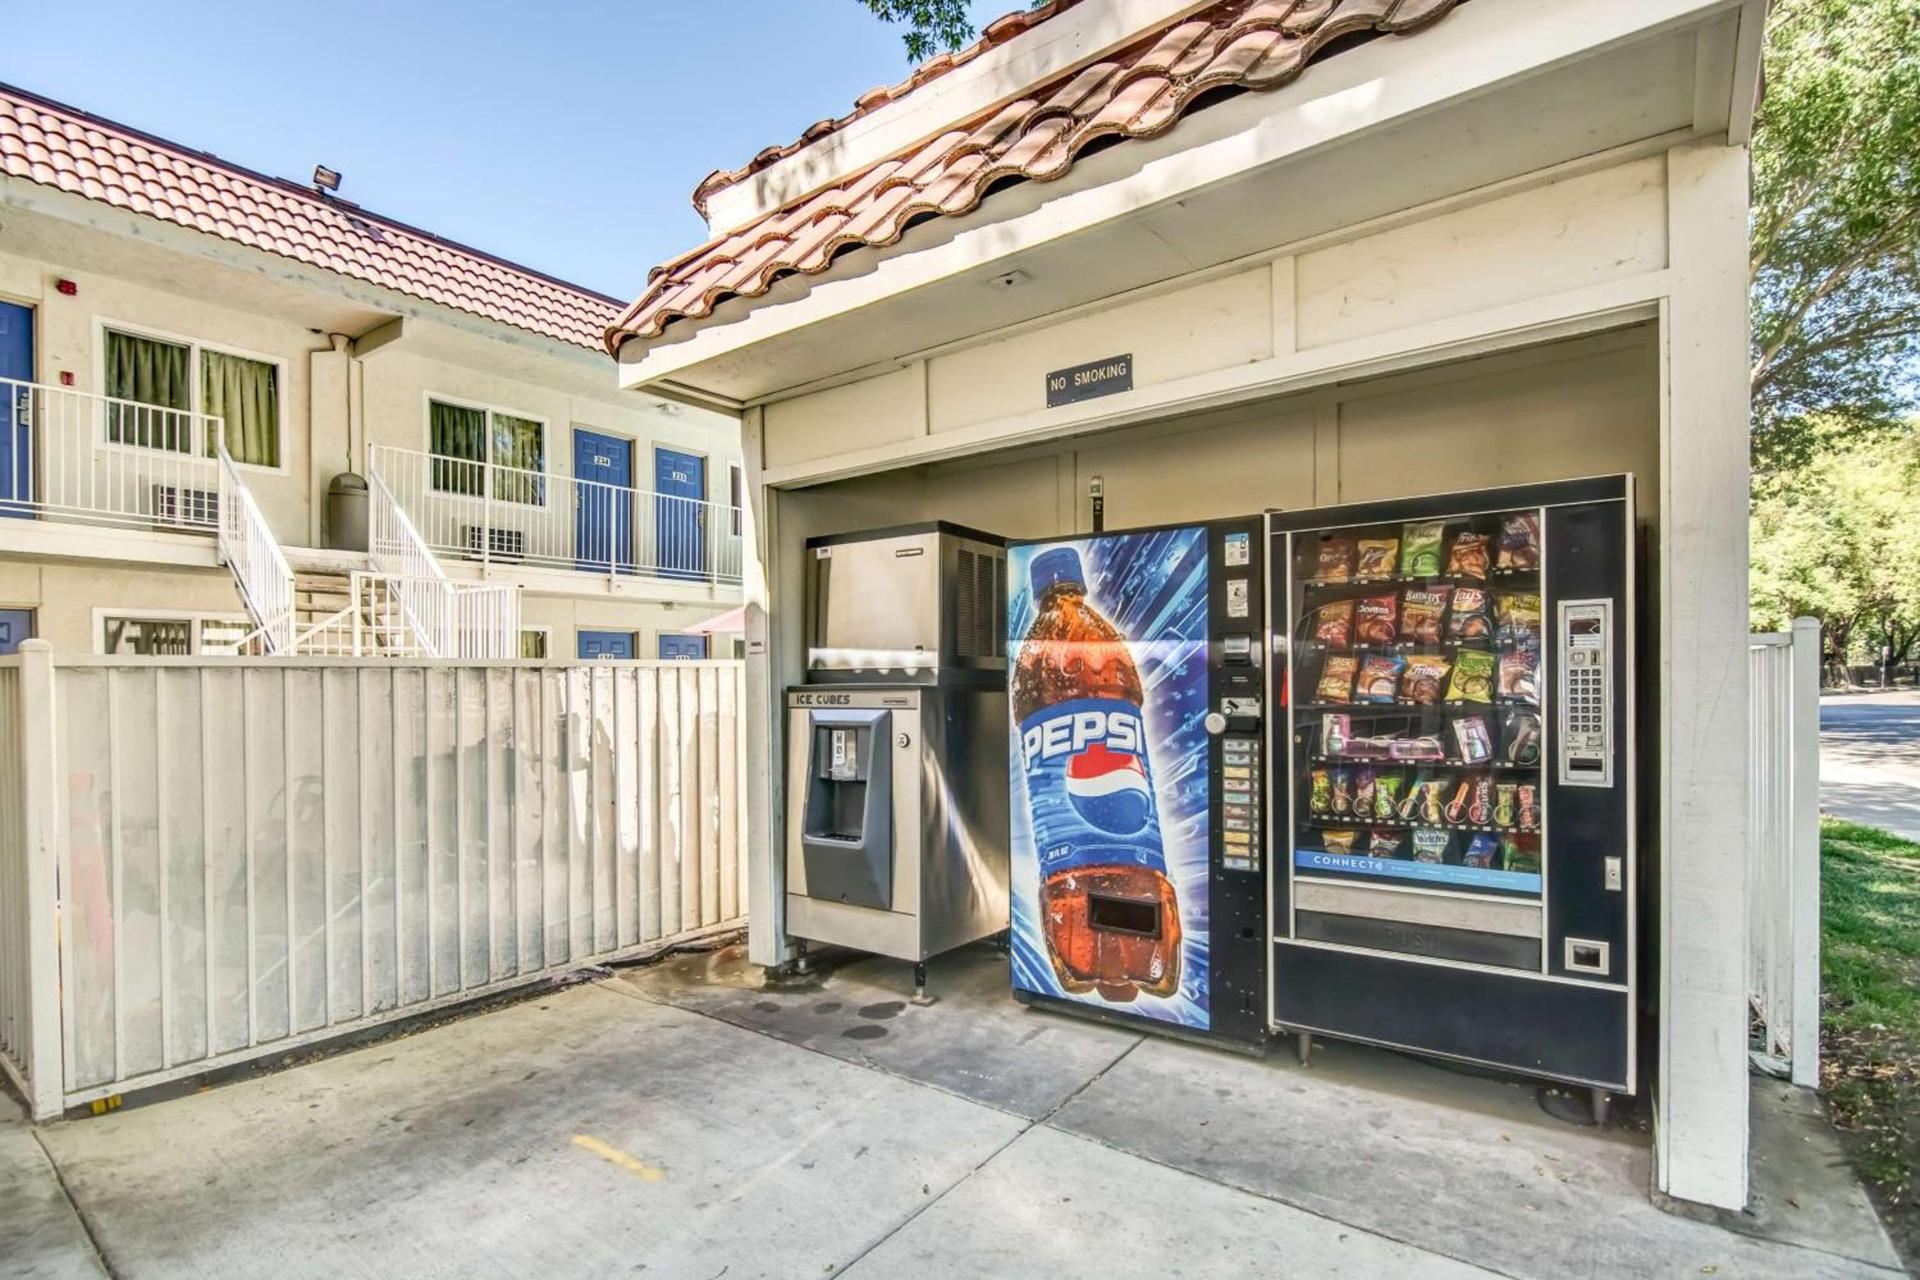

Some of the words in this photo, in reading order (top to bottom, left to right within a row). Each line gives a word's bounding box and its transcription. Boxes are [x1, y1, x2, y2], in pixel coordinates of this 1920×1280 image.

[1050, 377, 1067, 391] NO
[1074, 362, 1127, 386] SMOKING
[796, 694, 812, 705] ICE
[816, 694, 850, 705] CUBES
[1023, 711, 1143, 771] PEPSI
